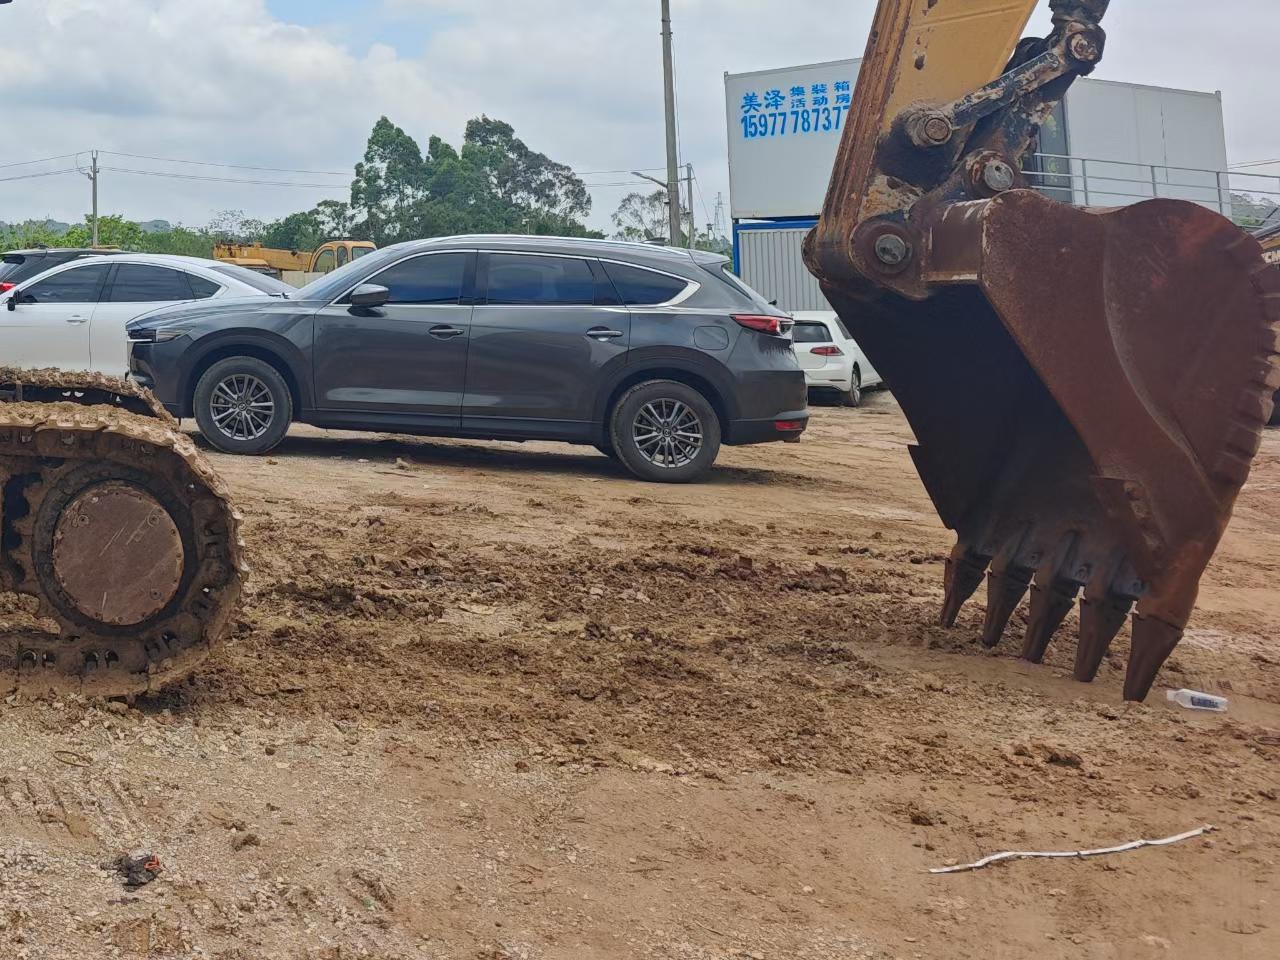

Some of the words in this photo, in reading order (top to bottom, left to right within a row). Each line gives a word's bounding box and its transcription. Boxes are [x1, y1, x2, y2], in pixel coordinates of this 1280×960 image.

[789, 81, 851, 97] 集装箱
[740, 89, 786, 114] 美泽
[790, 93, 851, 109] 活动房
